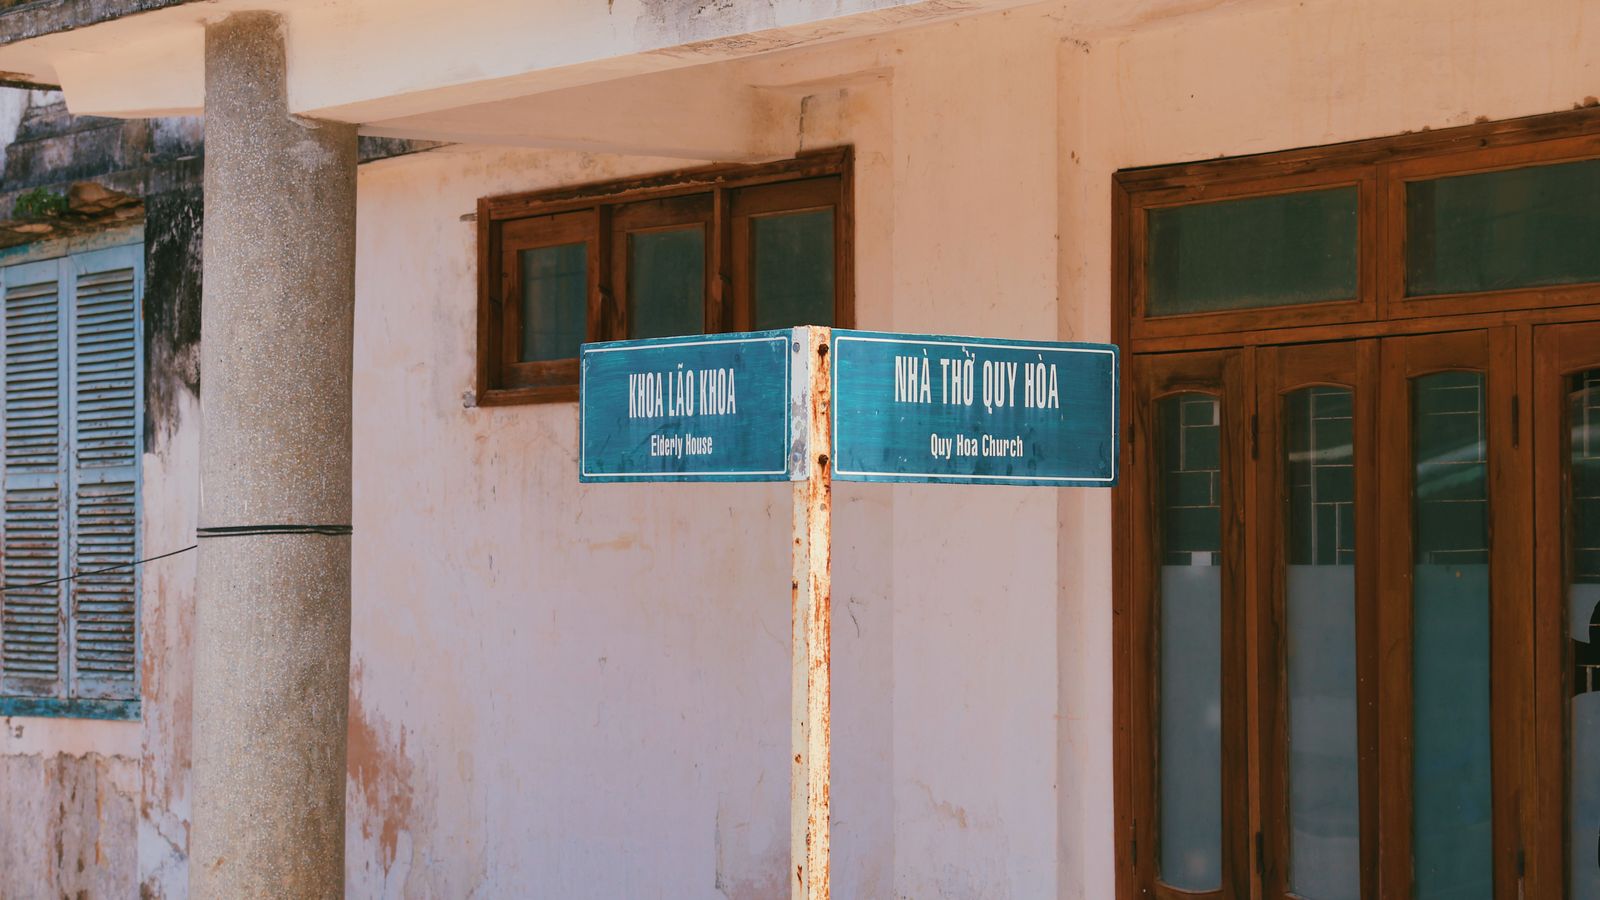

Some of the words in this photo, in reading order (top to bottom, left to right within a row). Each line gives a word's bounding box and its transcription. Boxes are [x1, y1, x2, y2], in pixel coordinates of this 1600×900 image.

[629, 372, 664, 418] KHOA
[668, 363, 694, 417] LÃO
[699, 368, 736, 416] KHOA
[895, 348, 932, 404] NHÀ
[940, 350, 975, 407] THỜ
[982, 360, 1018, 414] QUY
[1025, 354, 1060, 409] HÒA
[651, 434, 683, 460] Elderly
[685, 433, 713, 455] House
[930, 433, 952, 460] Quy
[956, 434, 978, 457] Hoa
[982, 434, 1023, 458] Church
